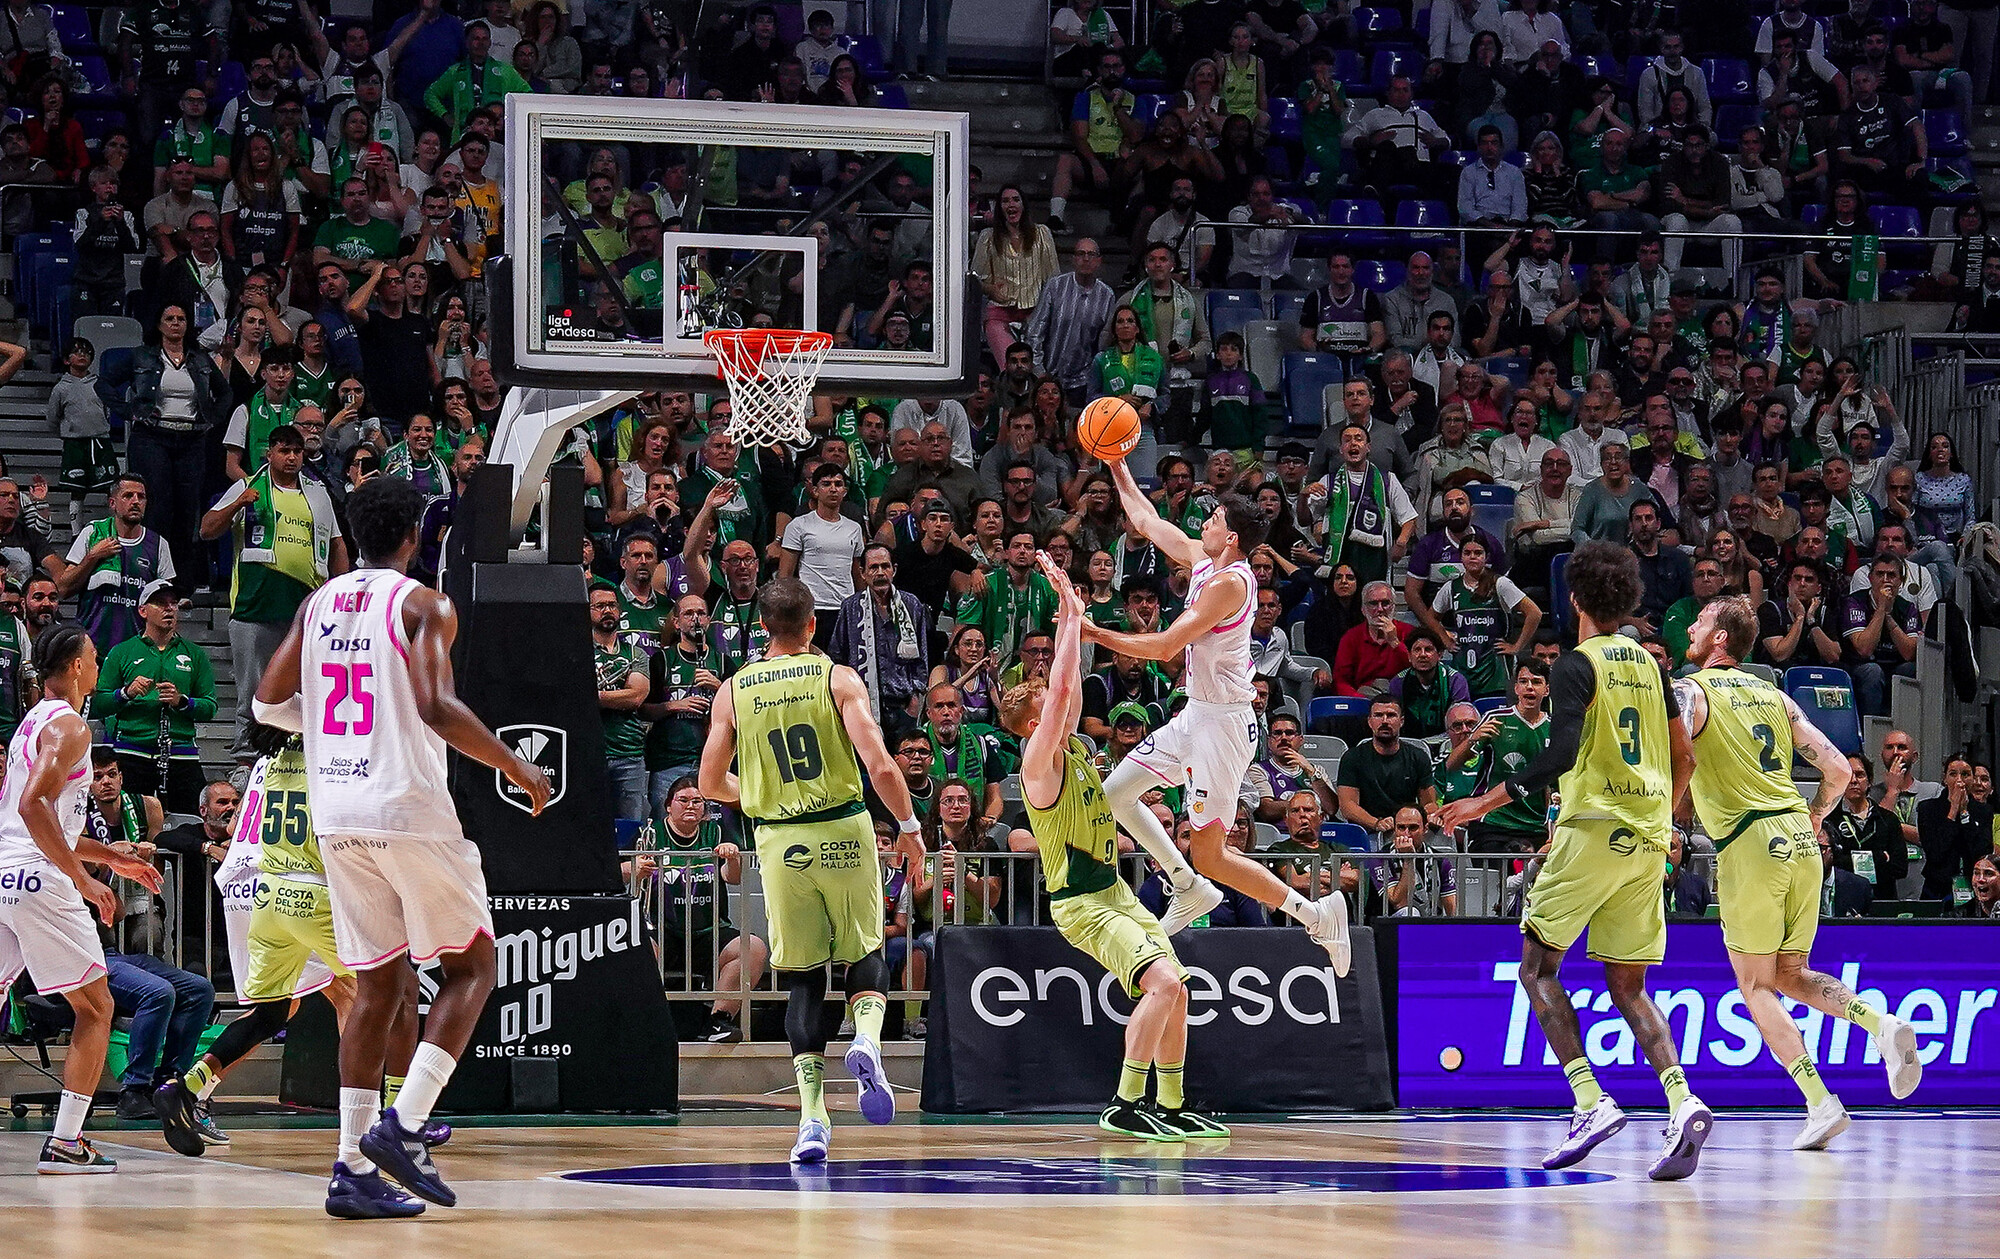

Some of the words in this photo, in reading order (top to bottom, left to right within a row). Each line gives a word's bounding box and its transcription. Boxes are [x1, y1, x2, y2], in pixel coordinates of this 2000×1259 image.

[252, 210, 282, 220] Unicaja
[245, 225, 276, 236] málaga
[548, 315, 570, 327] liga
[548, 326, 596, 338] endesa
[121, 575, 147, 588] nicaja
[102, 593, 137, 607] málaga
[1464, 616, 1495, 626] Unicaja
[330, 638, 371, 651] DISA
[1459, 633, 1489, 644] málaga
[321, 663, 374, 735] 25
[1618, 706, 1642, 765] 3
[767, 723, 823, 784] 19
[1752, 723, 1783, 773] 2
[330, 757, 353, 768] Islas
[262, 790, 308, 846] 55
[819, 839, 861, 851] COSTA
[820, 852, 841, 861] DEL
[844, 851, 861, 860] SOL
[820, 860, 862, 869] MÁLAGA
[277, 887, 314, 900] COSTA
[275, 897, 292, 908] DEL
[294, 899, 314, 910] SOL
[274, 906, 314, 919] MÁLAGA
[494, 898, 642, 989] Miguel
[500, 983, 552, 1044] 0,0
[1492, 960, 1998, 1068] Transaher
[475, 1045, 526, 1058] SINCE
[532, 1044, 572, 1056] 1890
